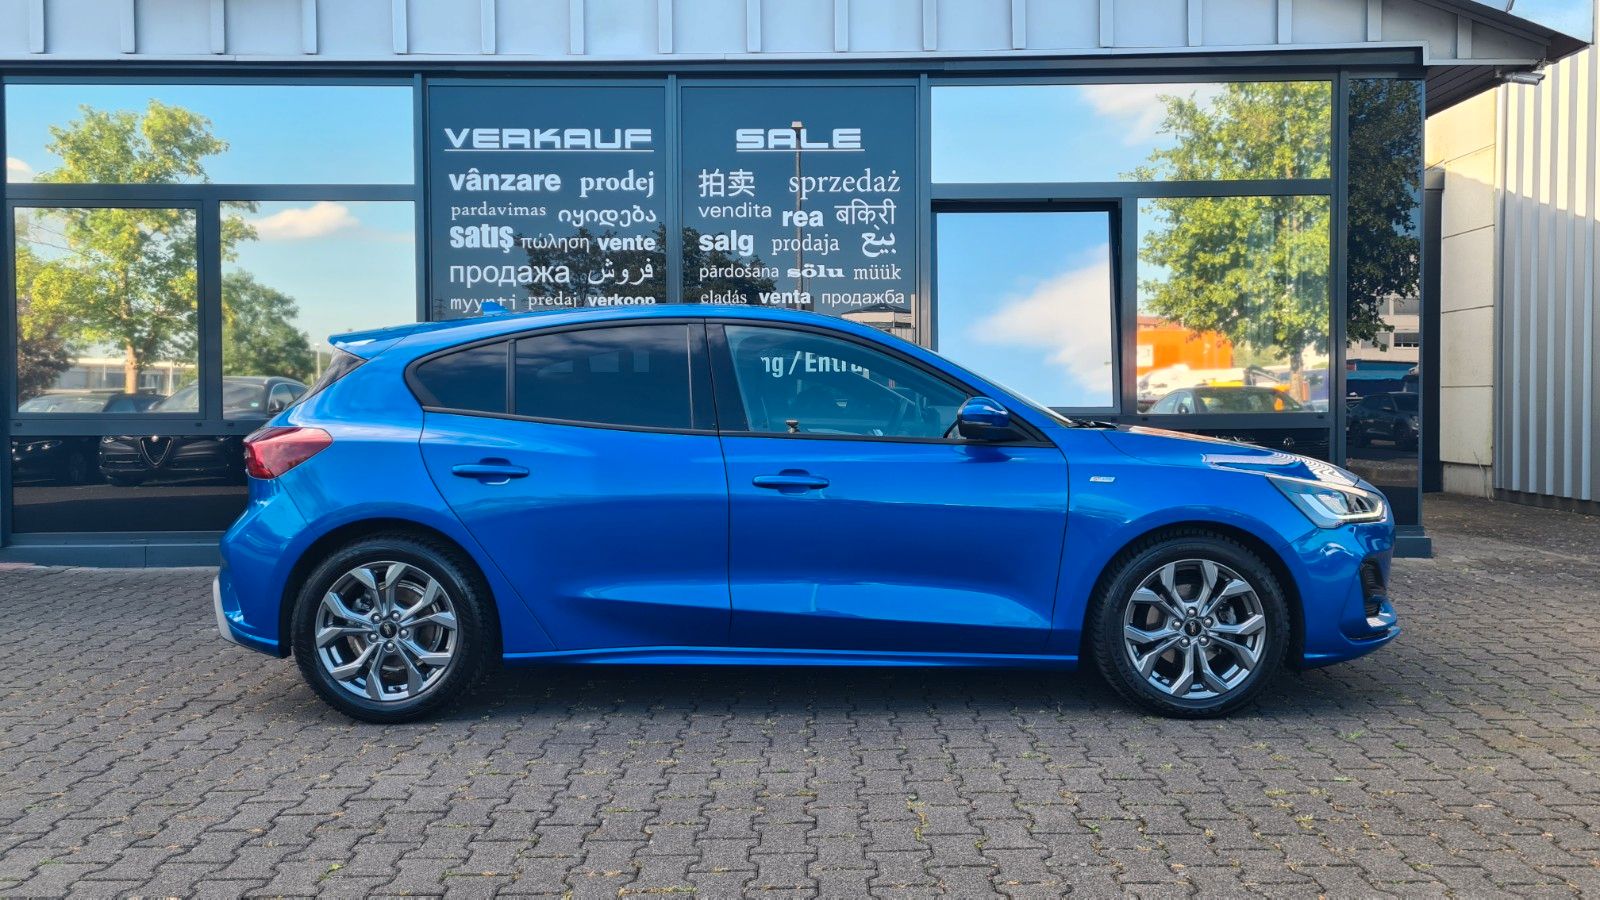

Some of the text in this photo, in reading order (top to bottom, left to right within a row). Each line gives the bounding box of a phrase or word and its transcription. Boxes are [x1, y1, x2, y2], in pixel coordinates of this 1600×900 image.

[444, 128, 652, 149] VERKAUF
[736, 128, 862, 149] SALE
[448, 167, 654, 198] vânzare prodej
[698, 168, 755, 197] 拍卖
[788, 168, 901, 200] sprzedaż
[451, 201, 546, 220] pardavimas
[558, 205, 657, 227] იყიდება
[698, 202, 824, 227] vendita rea
[450, 223, 514, 253] satış
[521, 233, 590, 252] πώληση
[597, 235, 656, 251] vente
[699, 229, 840, 257] salg prodaja
[450, 264, 570, 288] продажа
[700, 263, 779, 281] pārdošana
[853, 263, 902, 280] müük
[527, 291, 577, 310] predaj
[700, 289, 811, 305] eladás venta
[821, 289, 905, 307] продажба
